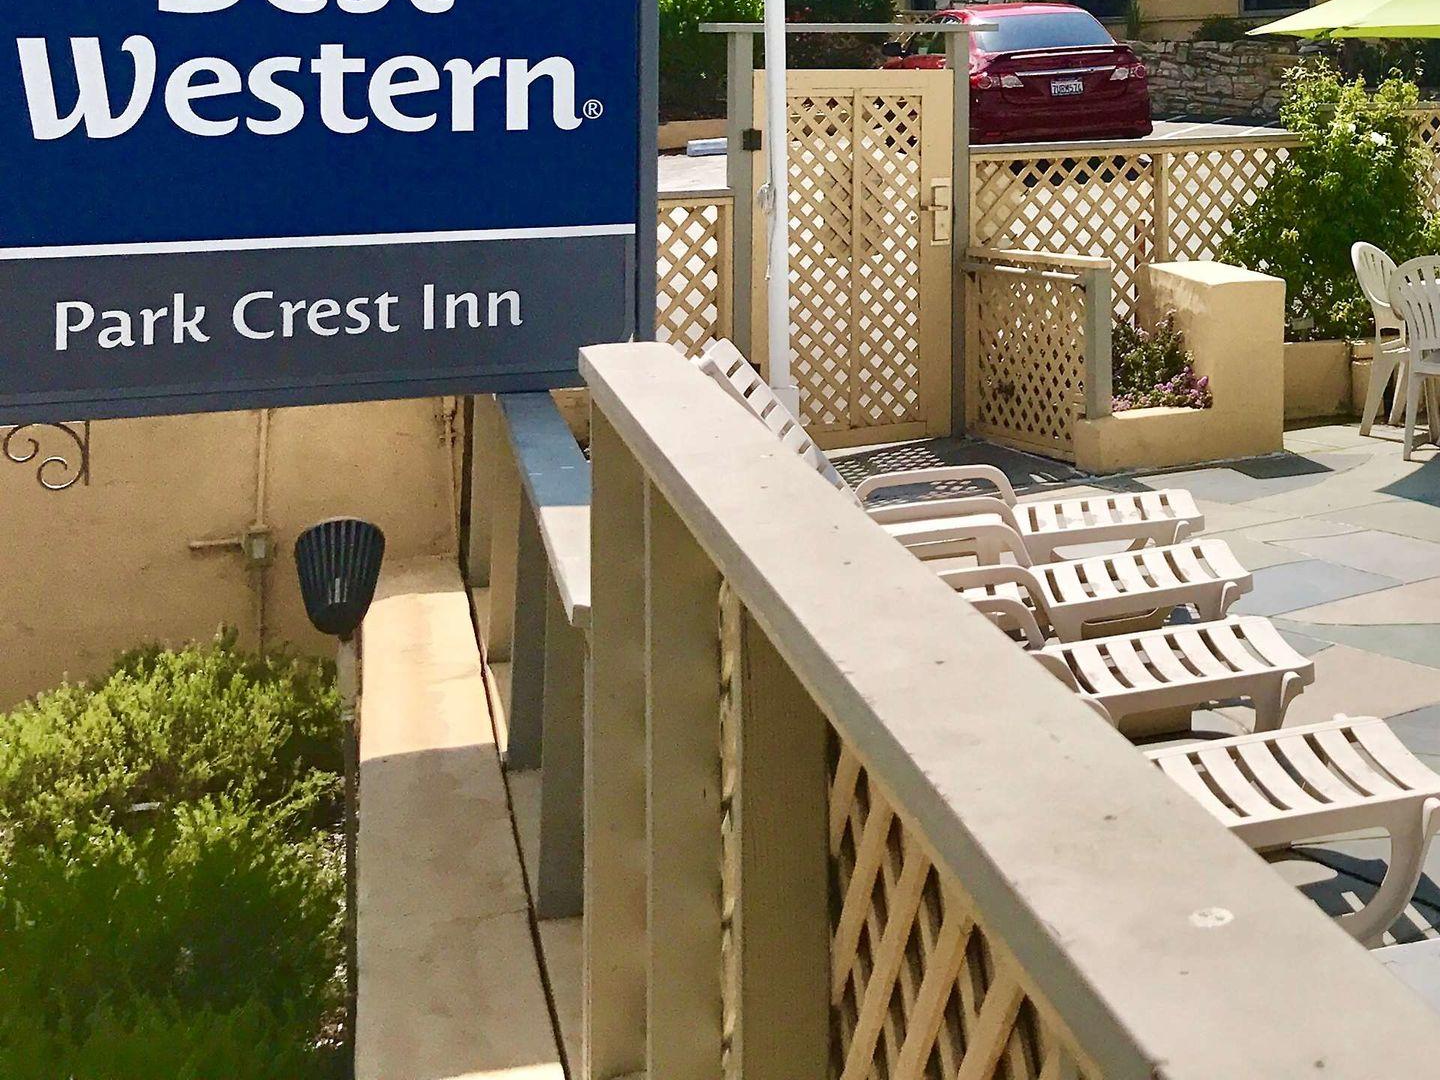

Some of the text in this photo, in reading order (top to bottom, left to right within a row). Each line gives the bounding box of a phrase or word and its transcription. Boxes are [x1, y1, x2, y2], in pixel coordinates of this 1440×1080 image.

[55, 283, 524, 351] Park Crest Inn
